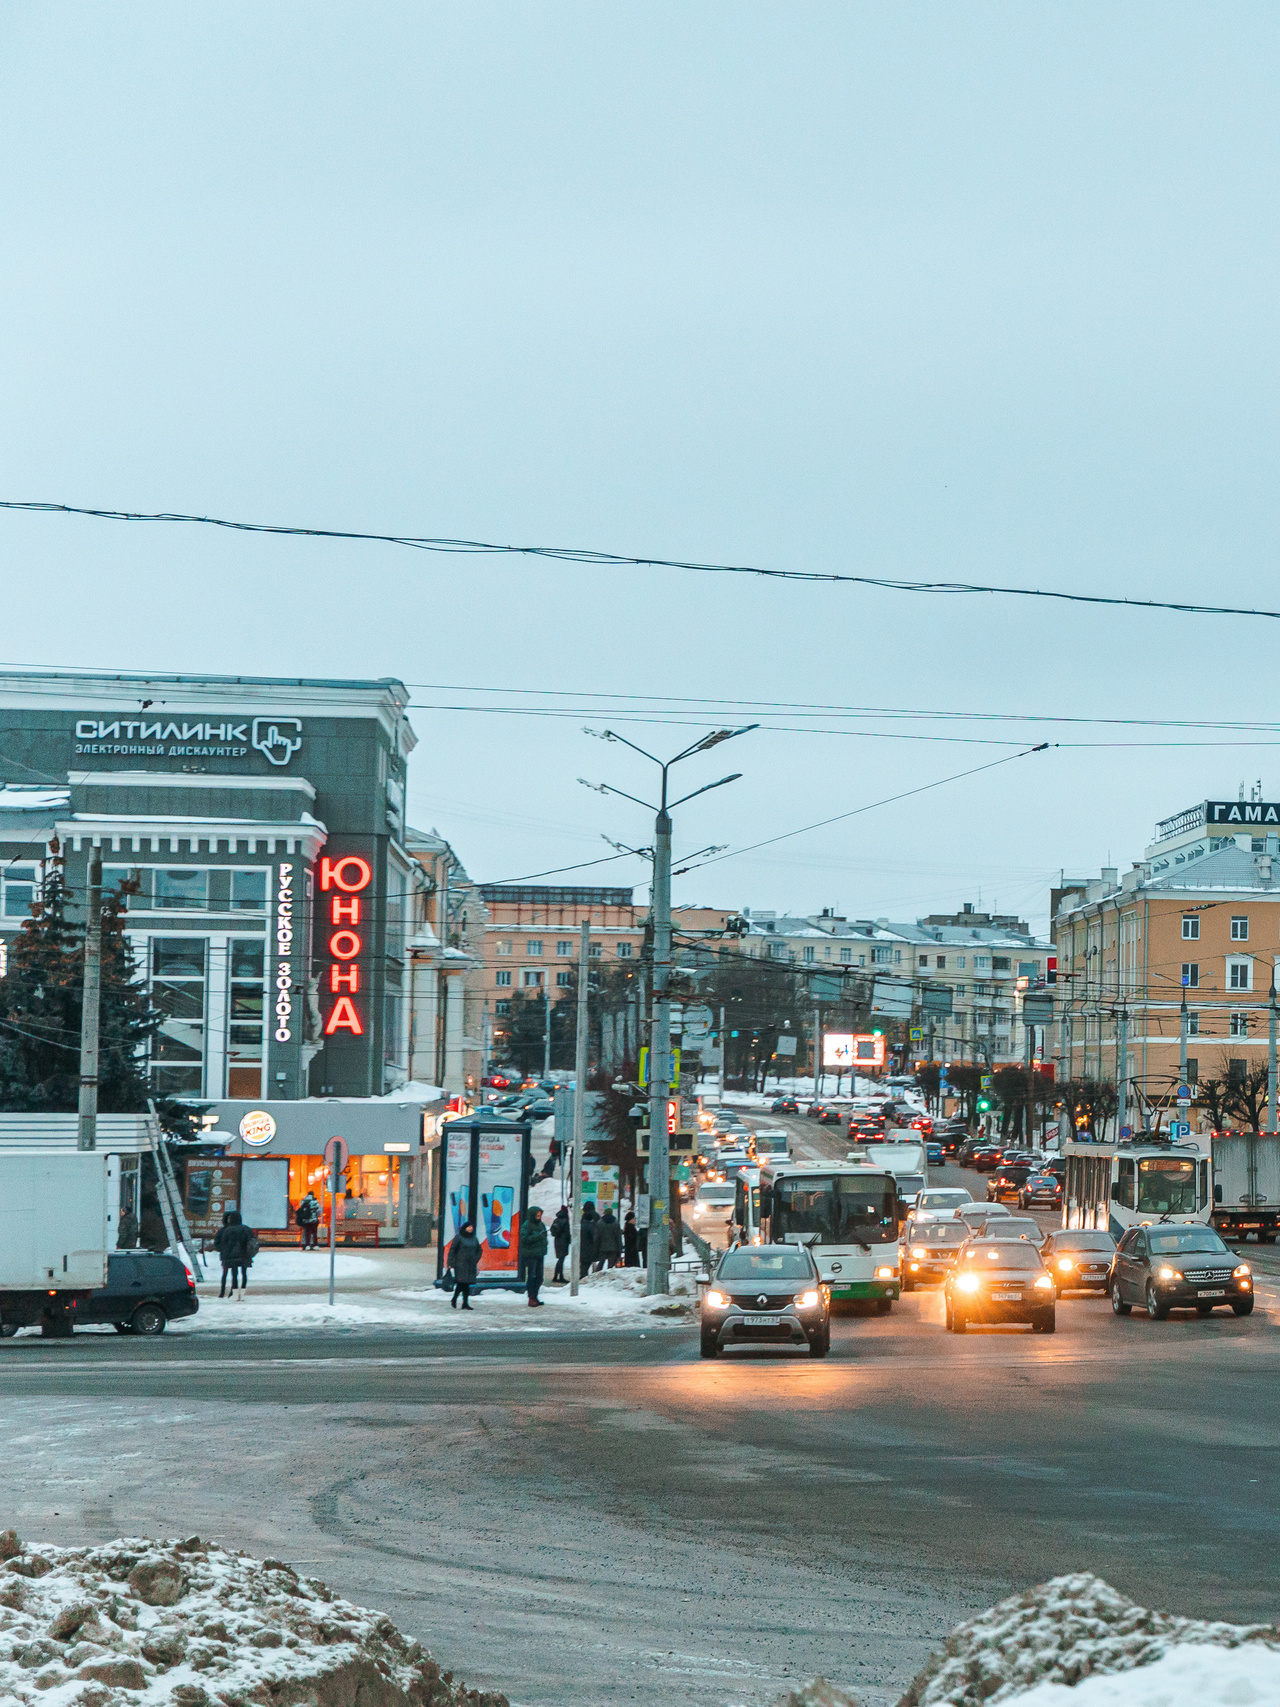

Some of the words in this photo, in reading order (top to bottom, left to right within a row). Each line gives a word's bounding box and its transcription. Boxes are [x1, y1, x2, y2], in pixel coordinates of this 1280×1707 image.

[75, 720, 248, 741] СИТИЛИНК
[75, 744, 165, 755] ЭЛЕКТРОННЫЙ
[168, 746, 247, 757] ДИСКАУНТЕР
[276, 862, 294, 957] РУССКОЕ
[319, 856, 372, 1036] ЮНОНА
[274, 961, 293, 1043] ЗОЛОТО
[245, 1123, 271, 1138] KING
